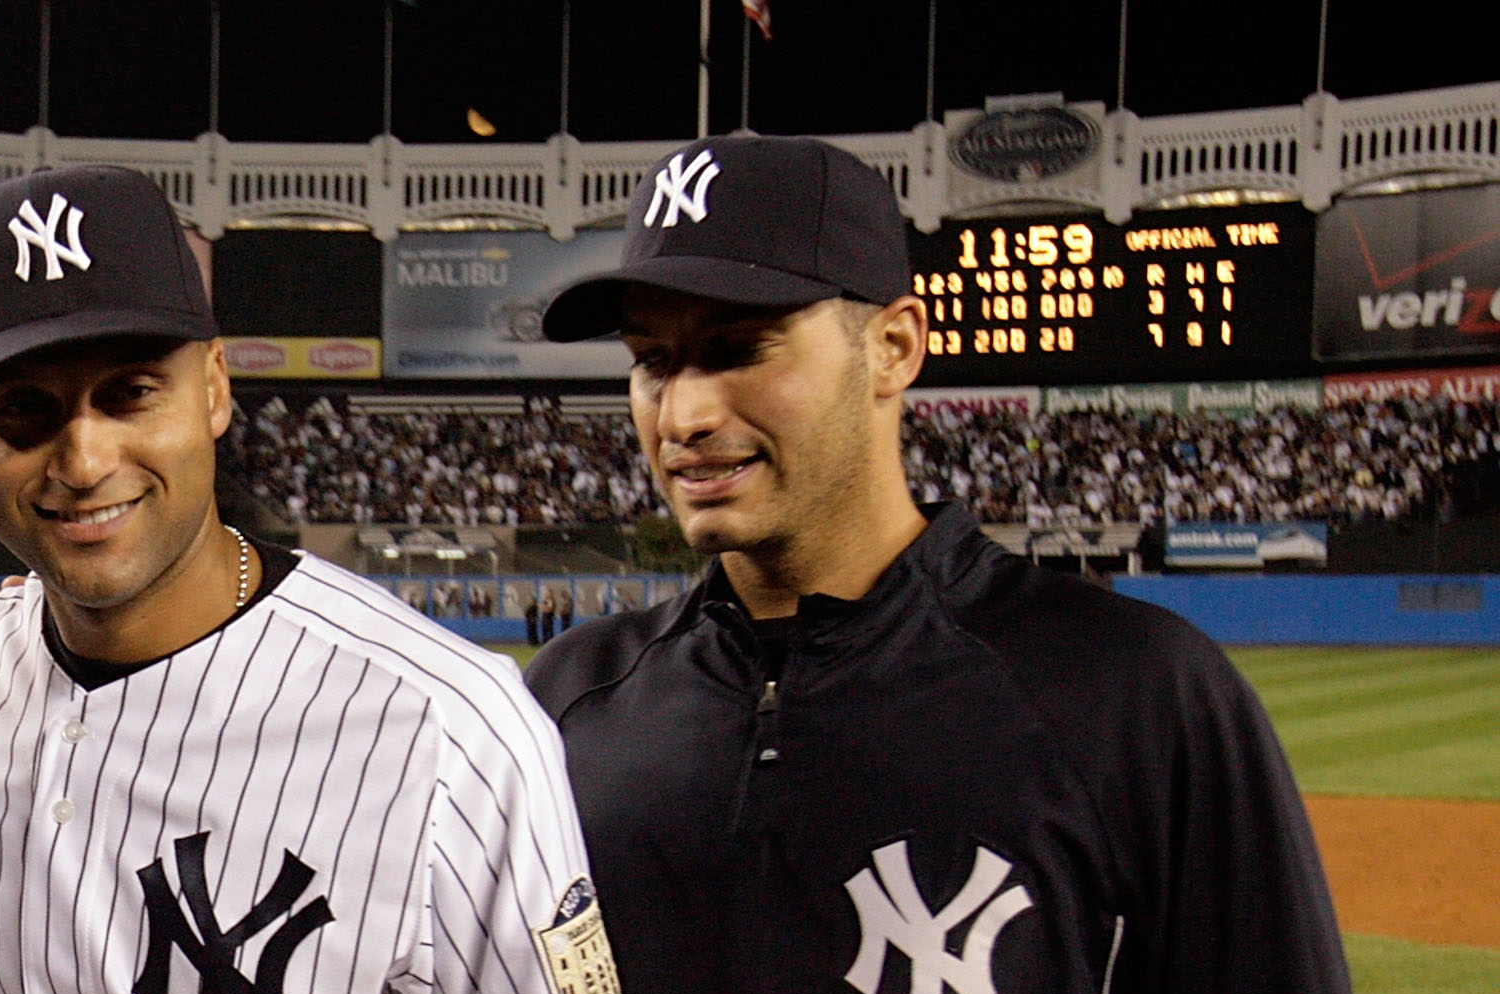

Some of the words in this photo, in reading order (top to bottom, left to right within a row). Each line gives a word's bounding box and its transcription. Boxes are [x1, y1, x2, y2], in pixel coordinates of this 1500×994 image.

[643, 149, 723, 228] NY
[8, 192, 92, 282] NY
[958, 223, 1094, 269] 11:59
[1226, 222, 1279, 246] TIME
[397, 262, 509, 288] MALIBU
[1358, 276, 1500, 334] veriz
[1439, 374, 1500, 403] AUT
